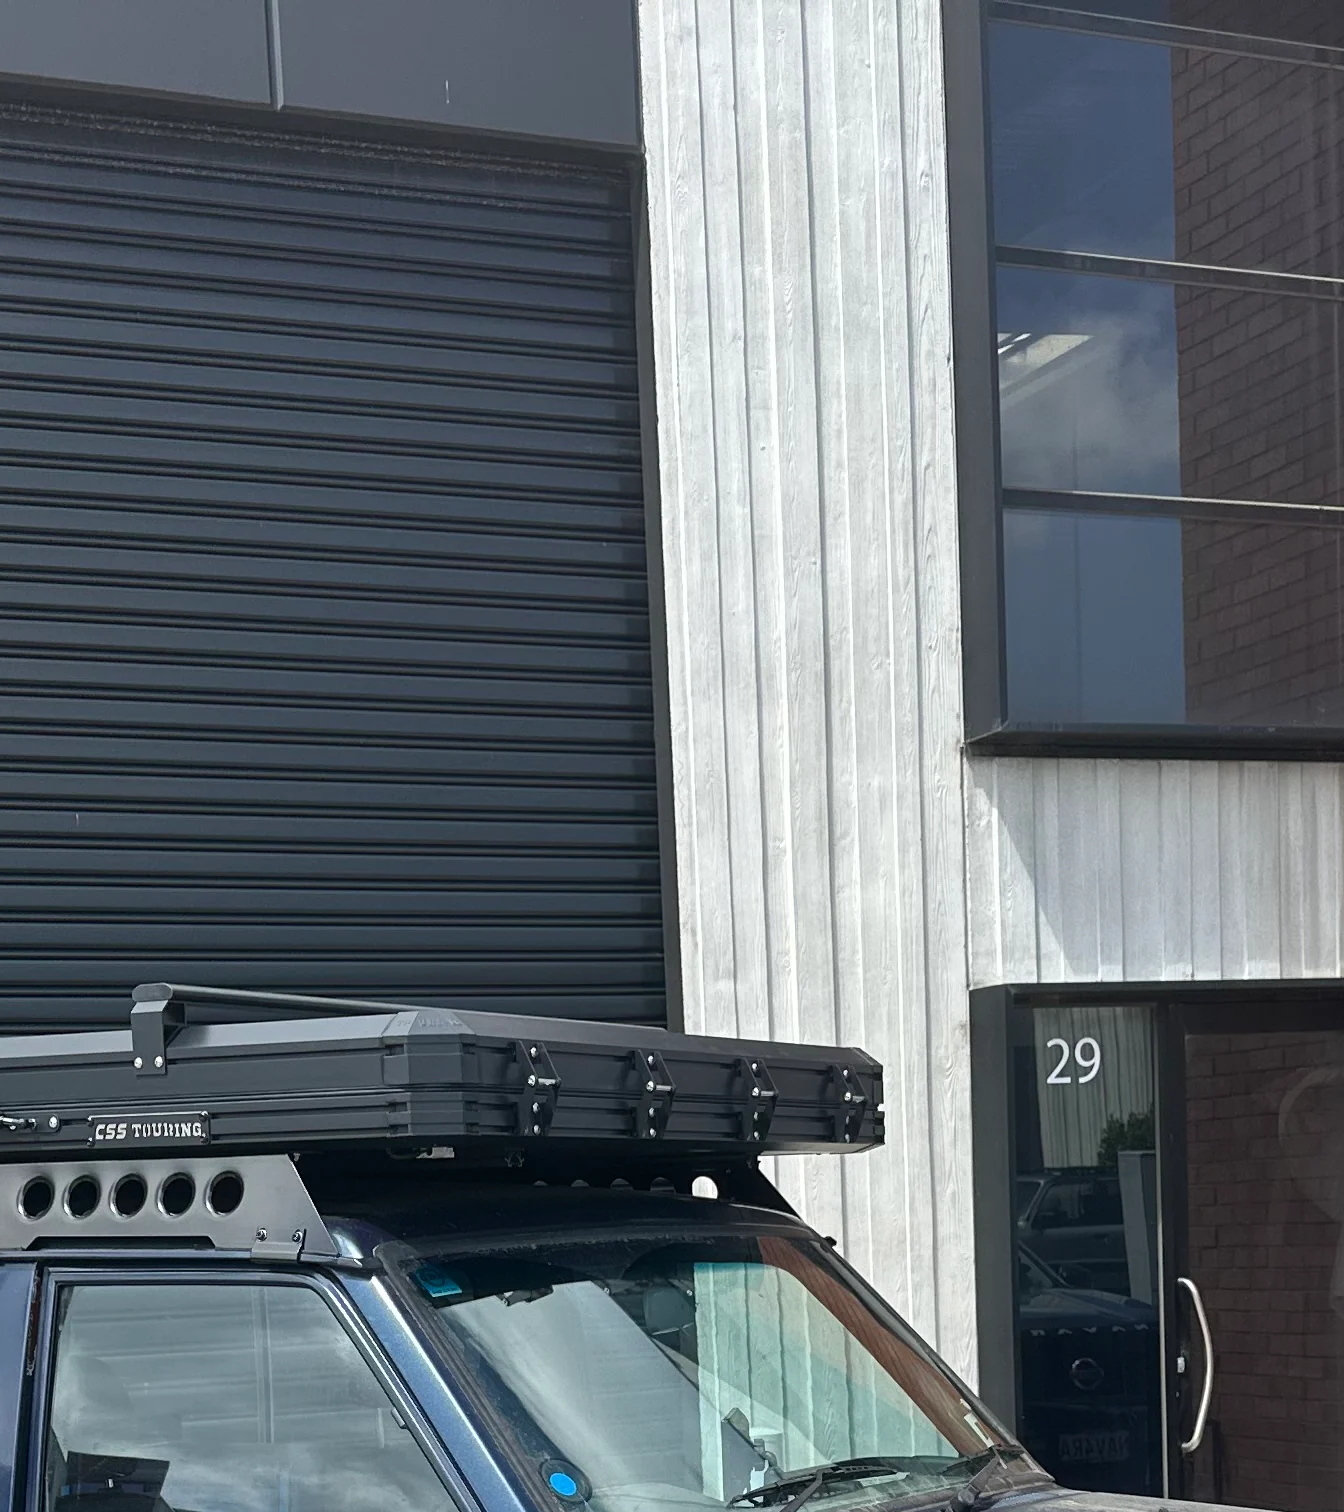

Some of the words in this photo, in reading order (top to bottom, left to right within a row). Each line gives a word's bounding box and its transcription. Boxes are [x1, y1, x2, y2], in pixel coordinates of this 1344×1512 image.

[1046, 1036, 1101, 1084] 29
[95, 1123, 128, 1140] CSS
[131, 1122, 202, 1138] TOURING
